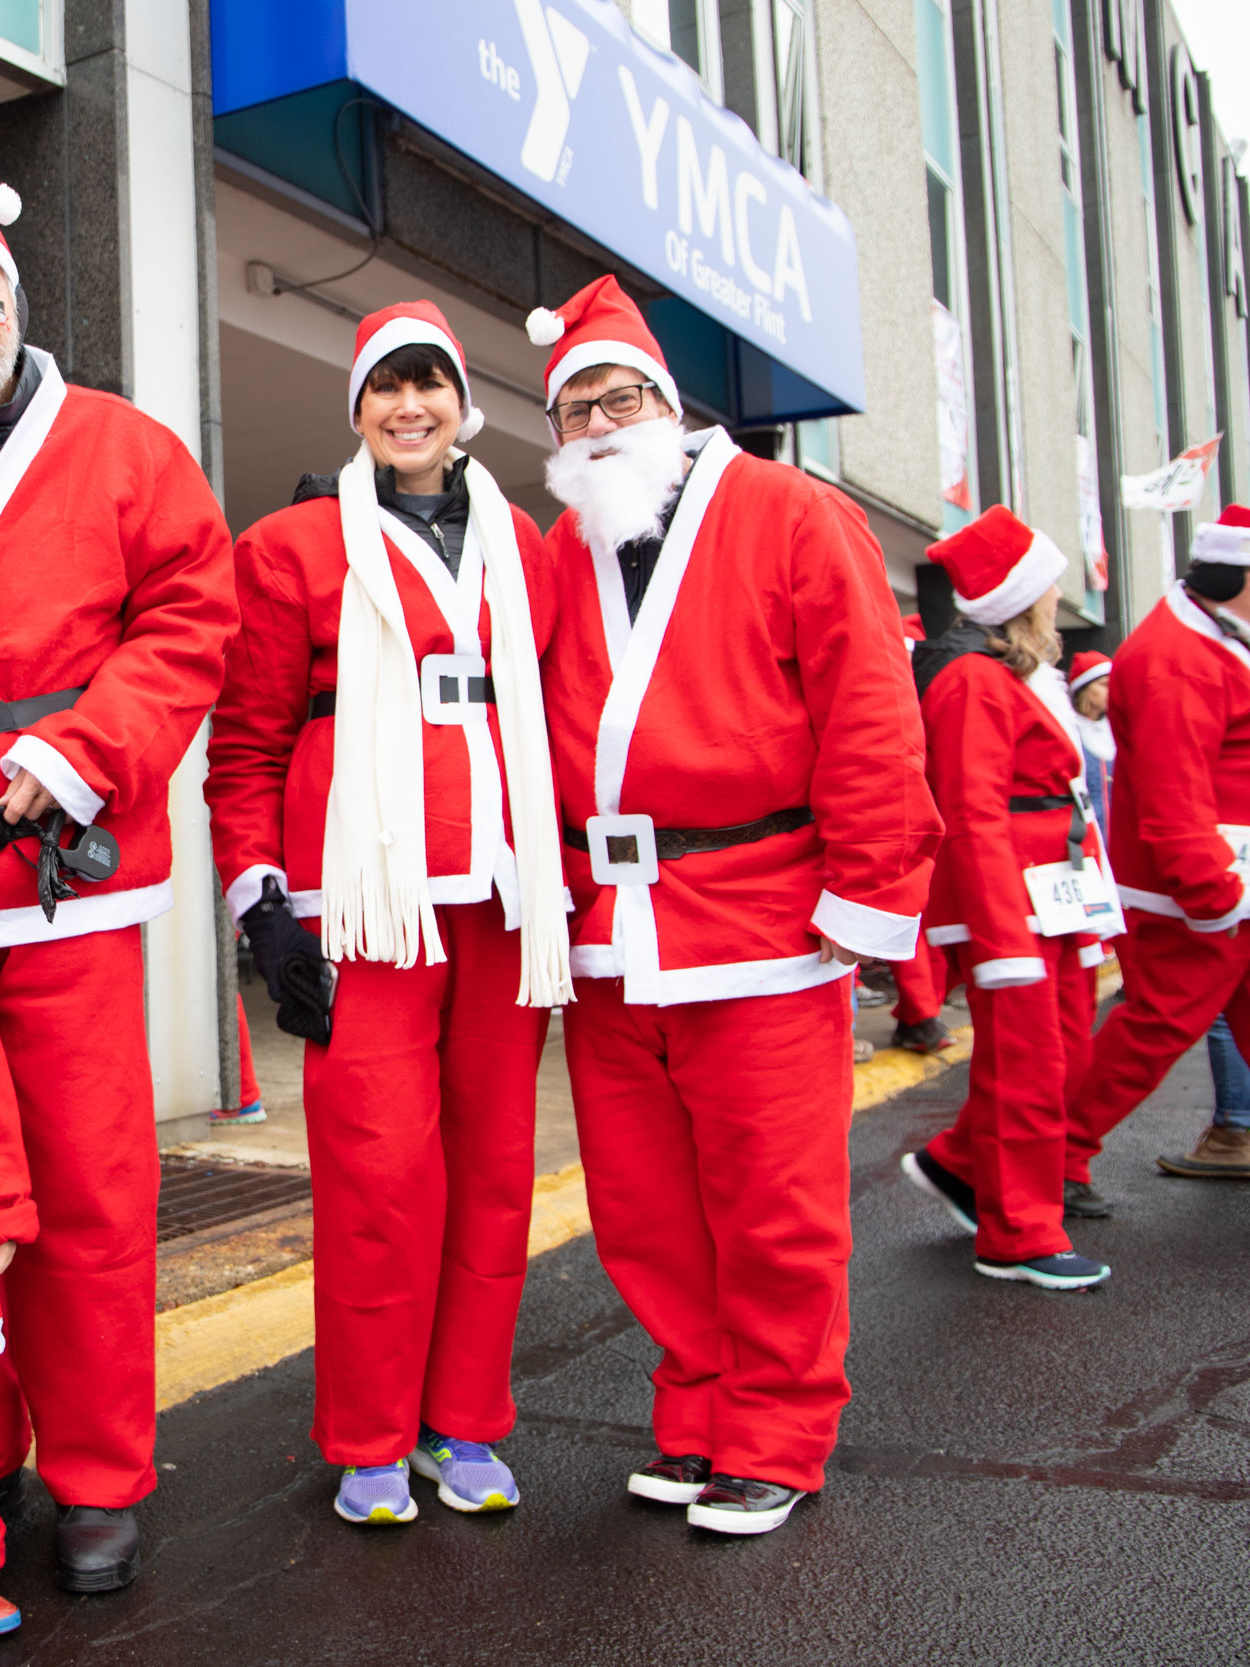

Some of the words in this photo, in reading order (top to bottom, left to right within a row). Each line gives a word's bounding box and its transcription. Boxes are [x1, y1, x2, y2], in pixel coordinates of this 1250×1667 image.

[478, 38, 521, 101] the
[618, 65, 811, 322] YMCA
[665, 229, 689, 277] Of
[691, 248, 752, 320] Greater
[1053, 879, 1083, 905] 436
